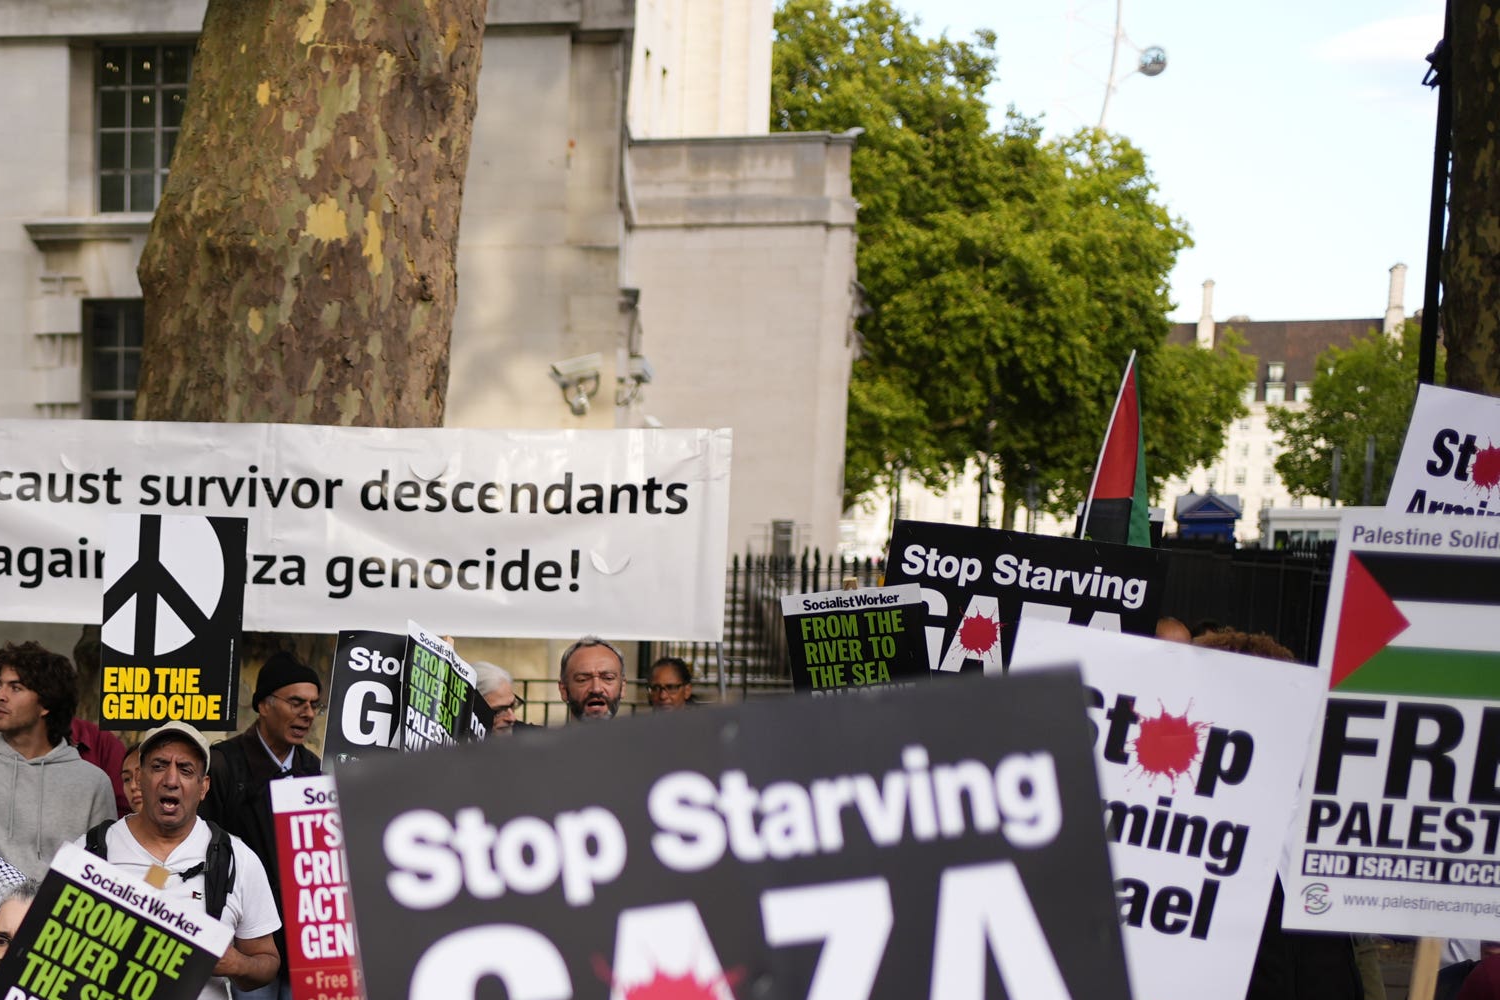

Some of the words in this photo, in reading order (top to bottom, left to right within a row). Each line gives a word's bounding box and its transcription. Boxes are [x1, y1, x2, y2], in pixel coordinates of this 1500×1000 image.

[1426, 427, 1500, 487] St
[139, 465, 342, 509] survivor
[360, 469, 689, 515] descendants
[1352, 525, 1442, 547] Palestine
[1449, 529, 1500, 549] Solid
[326, 547, 581, 599] genocide!
[901, 544, 983, 587] Stop
[992, 553, 1148, 610] Starving
[802, 596, 855, 611] Socialist
[854, 593, 900, 606] Worker
[800, 614, 859, 640] FROM
[864, 609, 905, 635] THE
[804, 638, 863, 665] RIVER
[868, 635, 896, 659] TO
[103, 667, 150, 692] END
[155, 667, 200, 694] THE
[411, 664, 448, 703] RIVER
[413, 644, 451, 683] FROM
[450, 671, 469, 703] THE
[806, 663, 847, 689] THE
[851, 660, 891, 686] SEA
[102, 693, 222, 720] GENOCIDE
[409, 685, 433, 718] THE
[435, 702, 453, 736] SEA
[289, 812, 343, 850] IT'S
[381, 806, 629, 911] Stop
[647, 744, 1063, 872] Starving
[1305, 853, 1350, 875] END
[1355, 856, 1443, 881] ISRAELI
[80, 863, 149, 913] Socialist
[148, 894, 203, 937] Worker
[298, 886, 348, 923] ACT
[51, 883, 137, 950] FROM
[134, 924, 193, 980] THE
[33, 917, 119, 986] RIVER
[315, 971, 348, 989] Free
